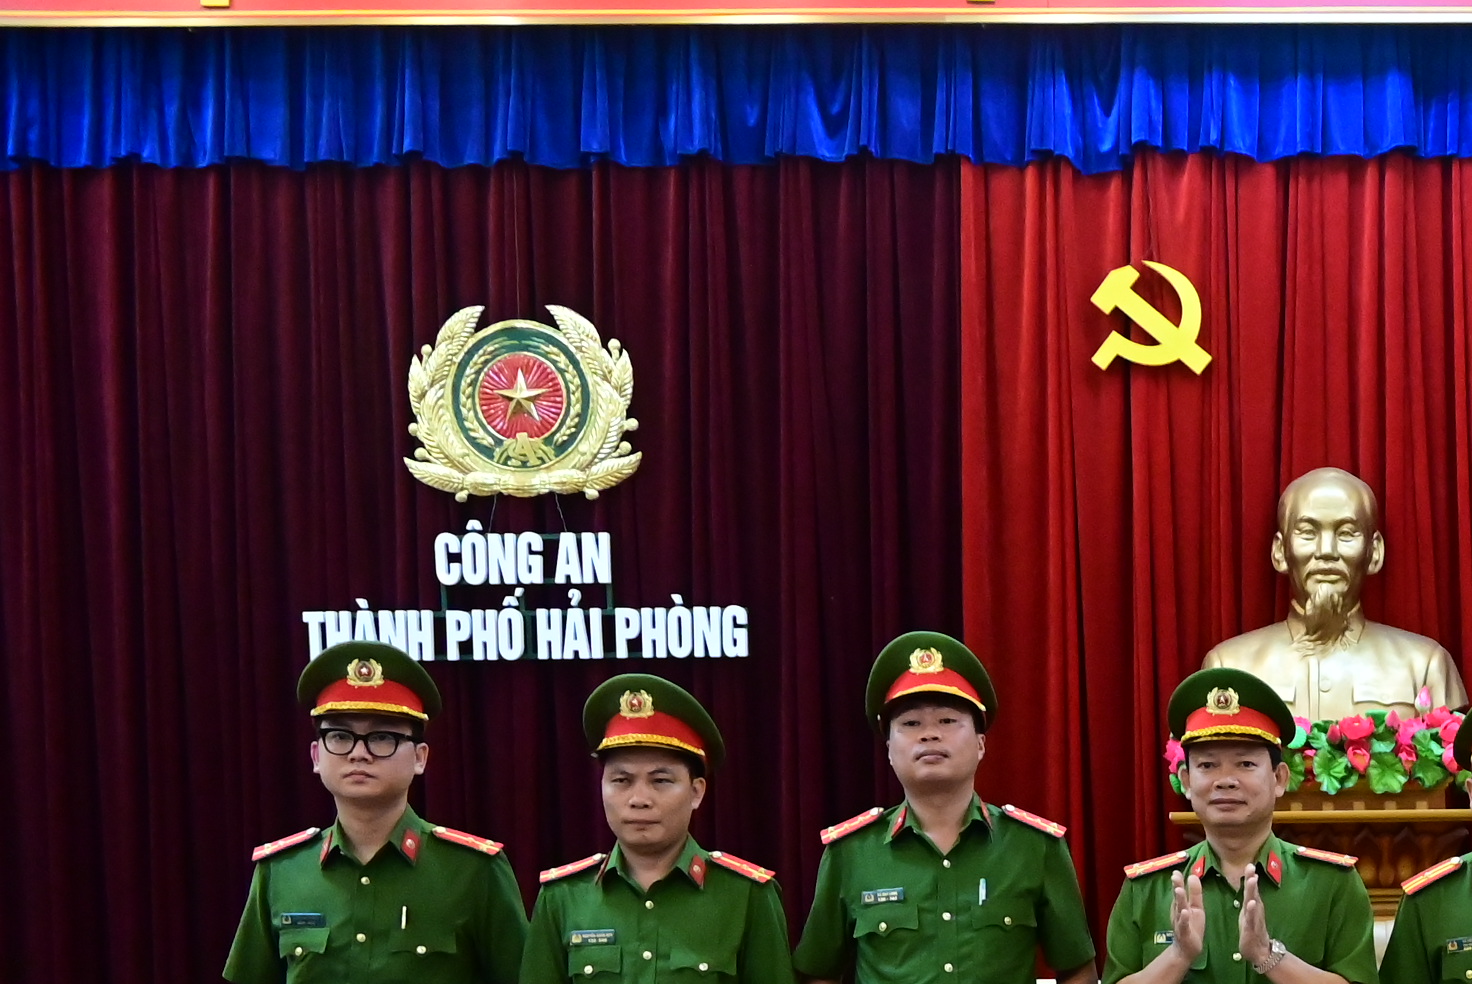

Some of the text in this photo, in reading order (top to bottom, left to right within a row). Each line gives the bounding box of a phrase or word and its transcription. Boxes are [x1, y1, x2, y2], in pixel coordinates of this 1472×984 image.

[435, 519, 612, 585] CÔNG AN
[446, 587, 525, 661] PHỐ
[536, 588, 604, 660] HẢI
[615, 593, 749, 658] PHÒNG
